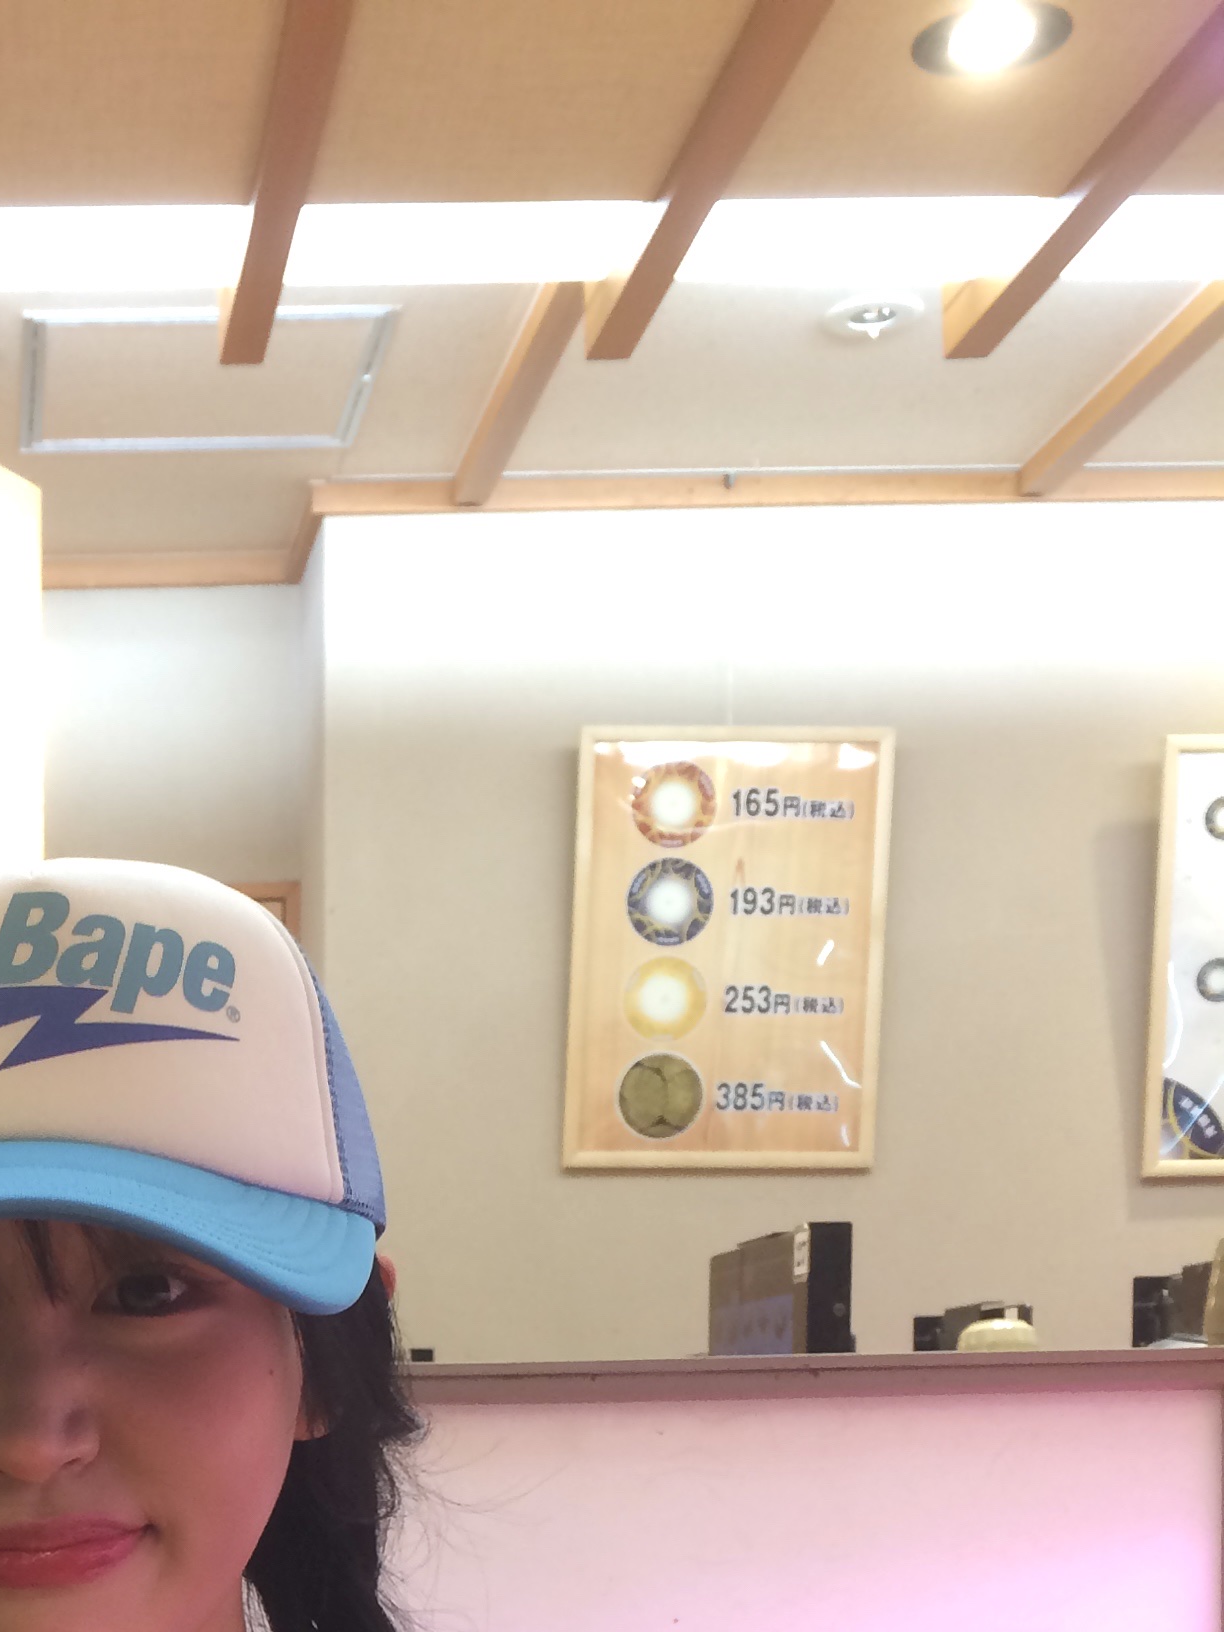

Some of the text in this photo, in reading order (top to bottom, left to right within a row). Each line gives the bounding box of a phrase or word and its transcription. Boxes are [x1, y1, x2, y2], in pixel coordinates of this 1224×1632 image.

[732, 787, 855, 820] 165円(税込)
[730, 886, 850, 915] 193円(税込)
[724, 984, 845, 1014] 253円(税込)
[716, 1082, 839, 1112] 385円(税込)
